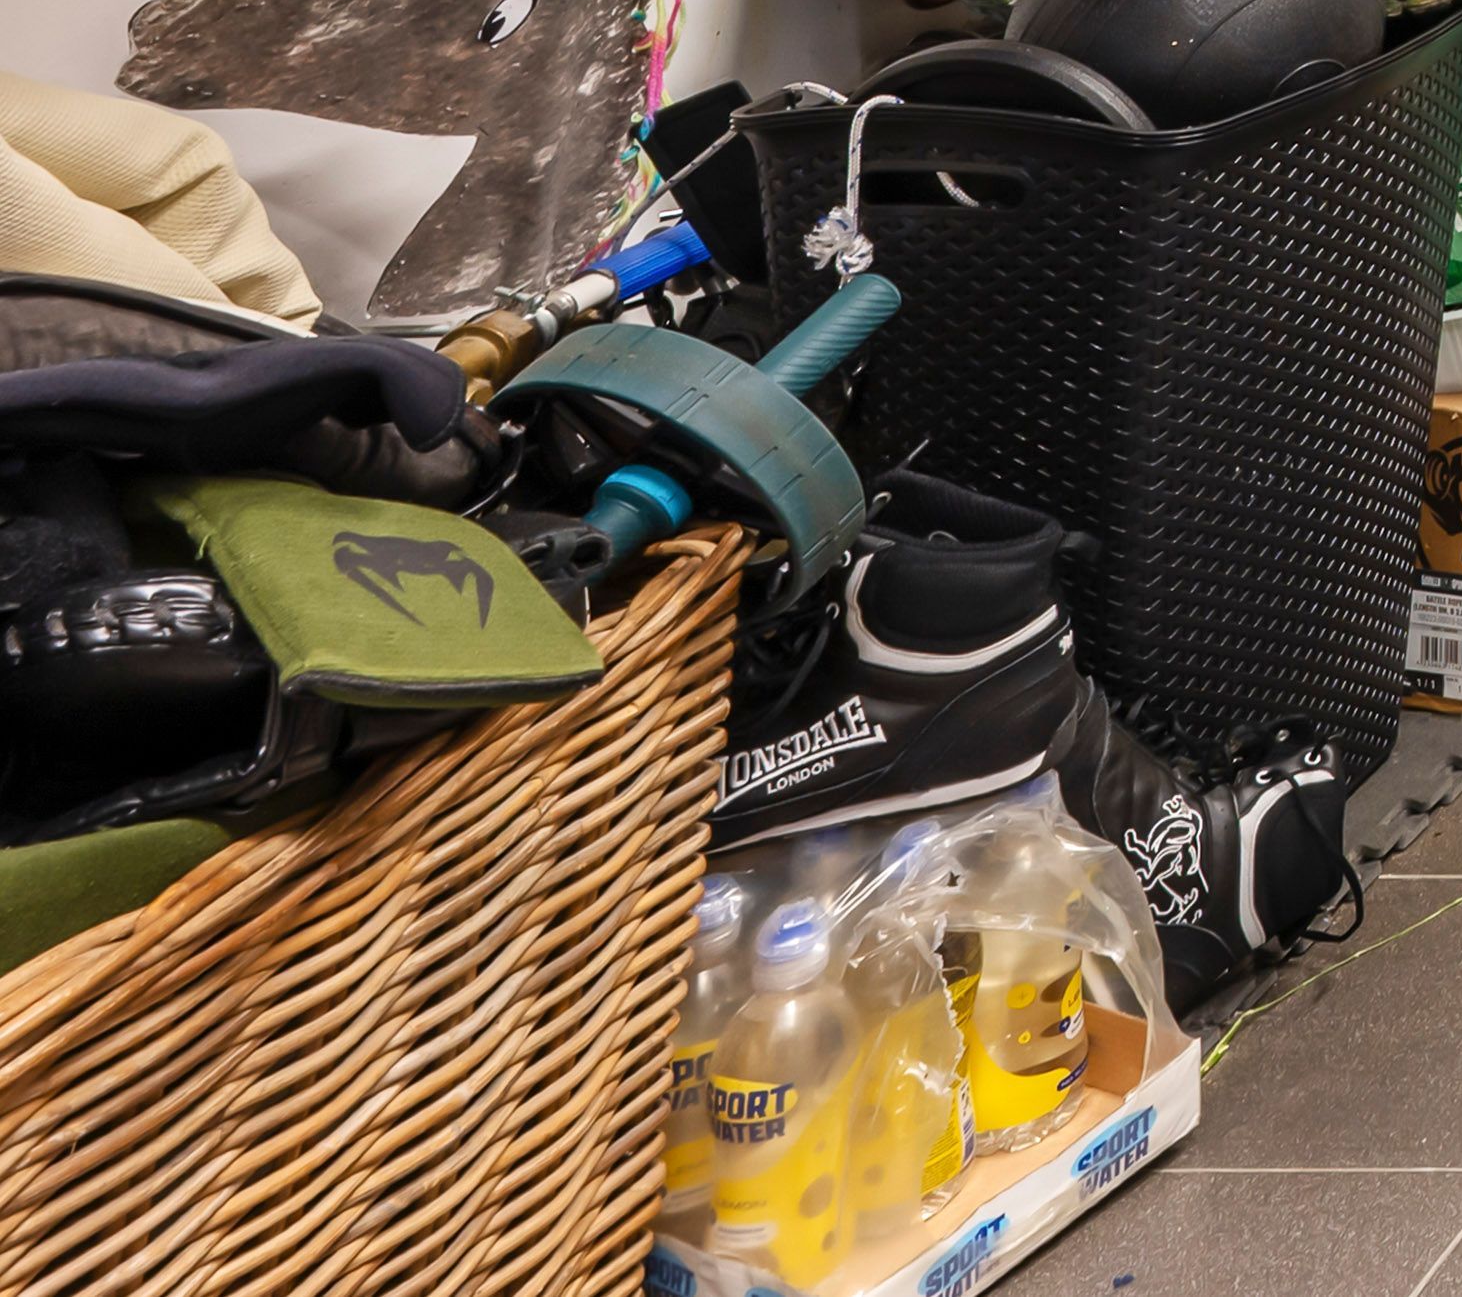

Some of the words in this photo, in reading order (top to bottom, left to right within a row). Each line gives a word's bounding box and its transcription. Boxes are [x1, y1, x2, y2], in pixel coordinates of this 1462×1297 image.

[766, 756, 835, 795] LONDON
[707, 1081, 795, 1122] SPORT
[1077, 1105, 1155, 1172] SPORT
[1079, 1135, 1149, 1201] WATER
